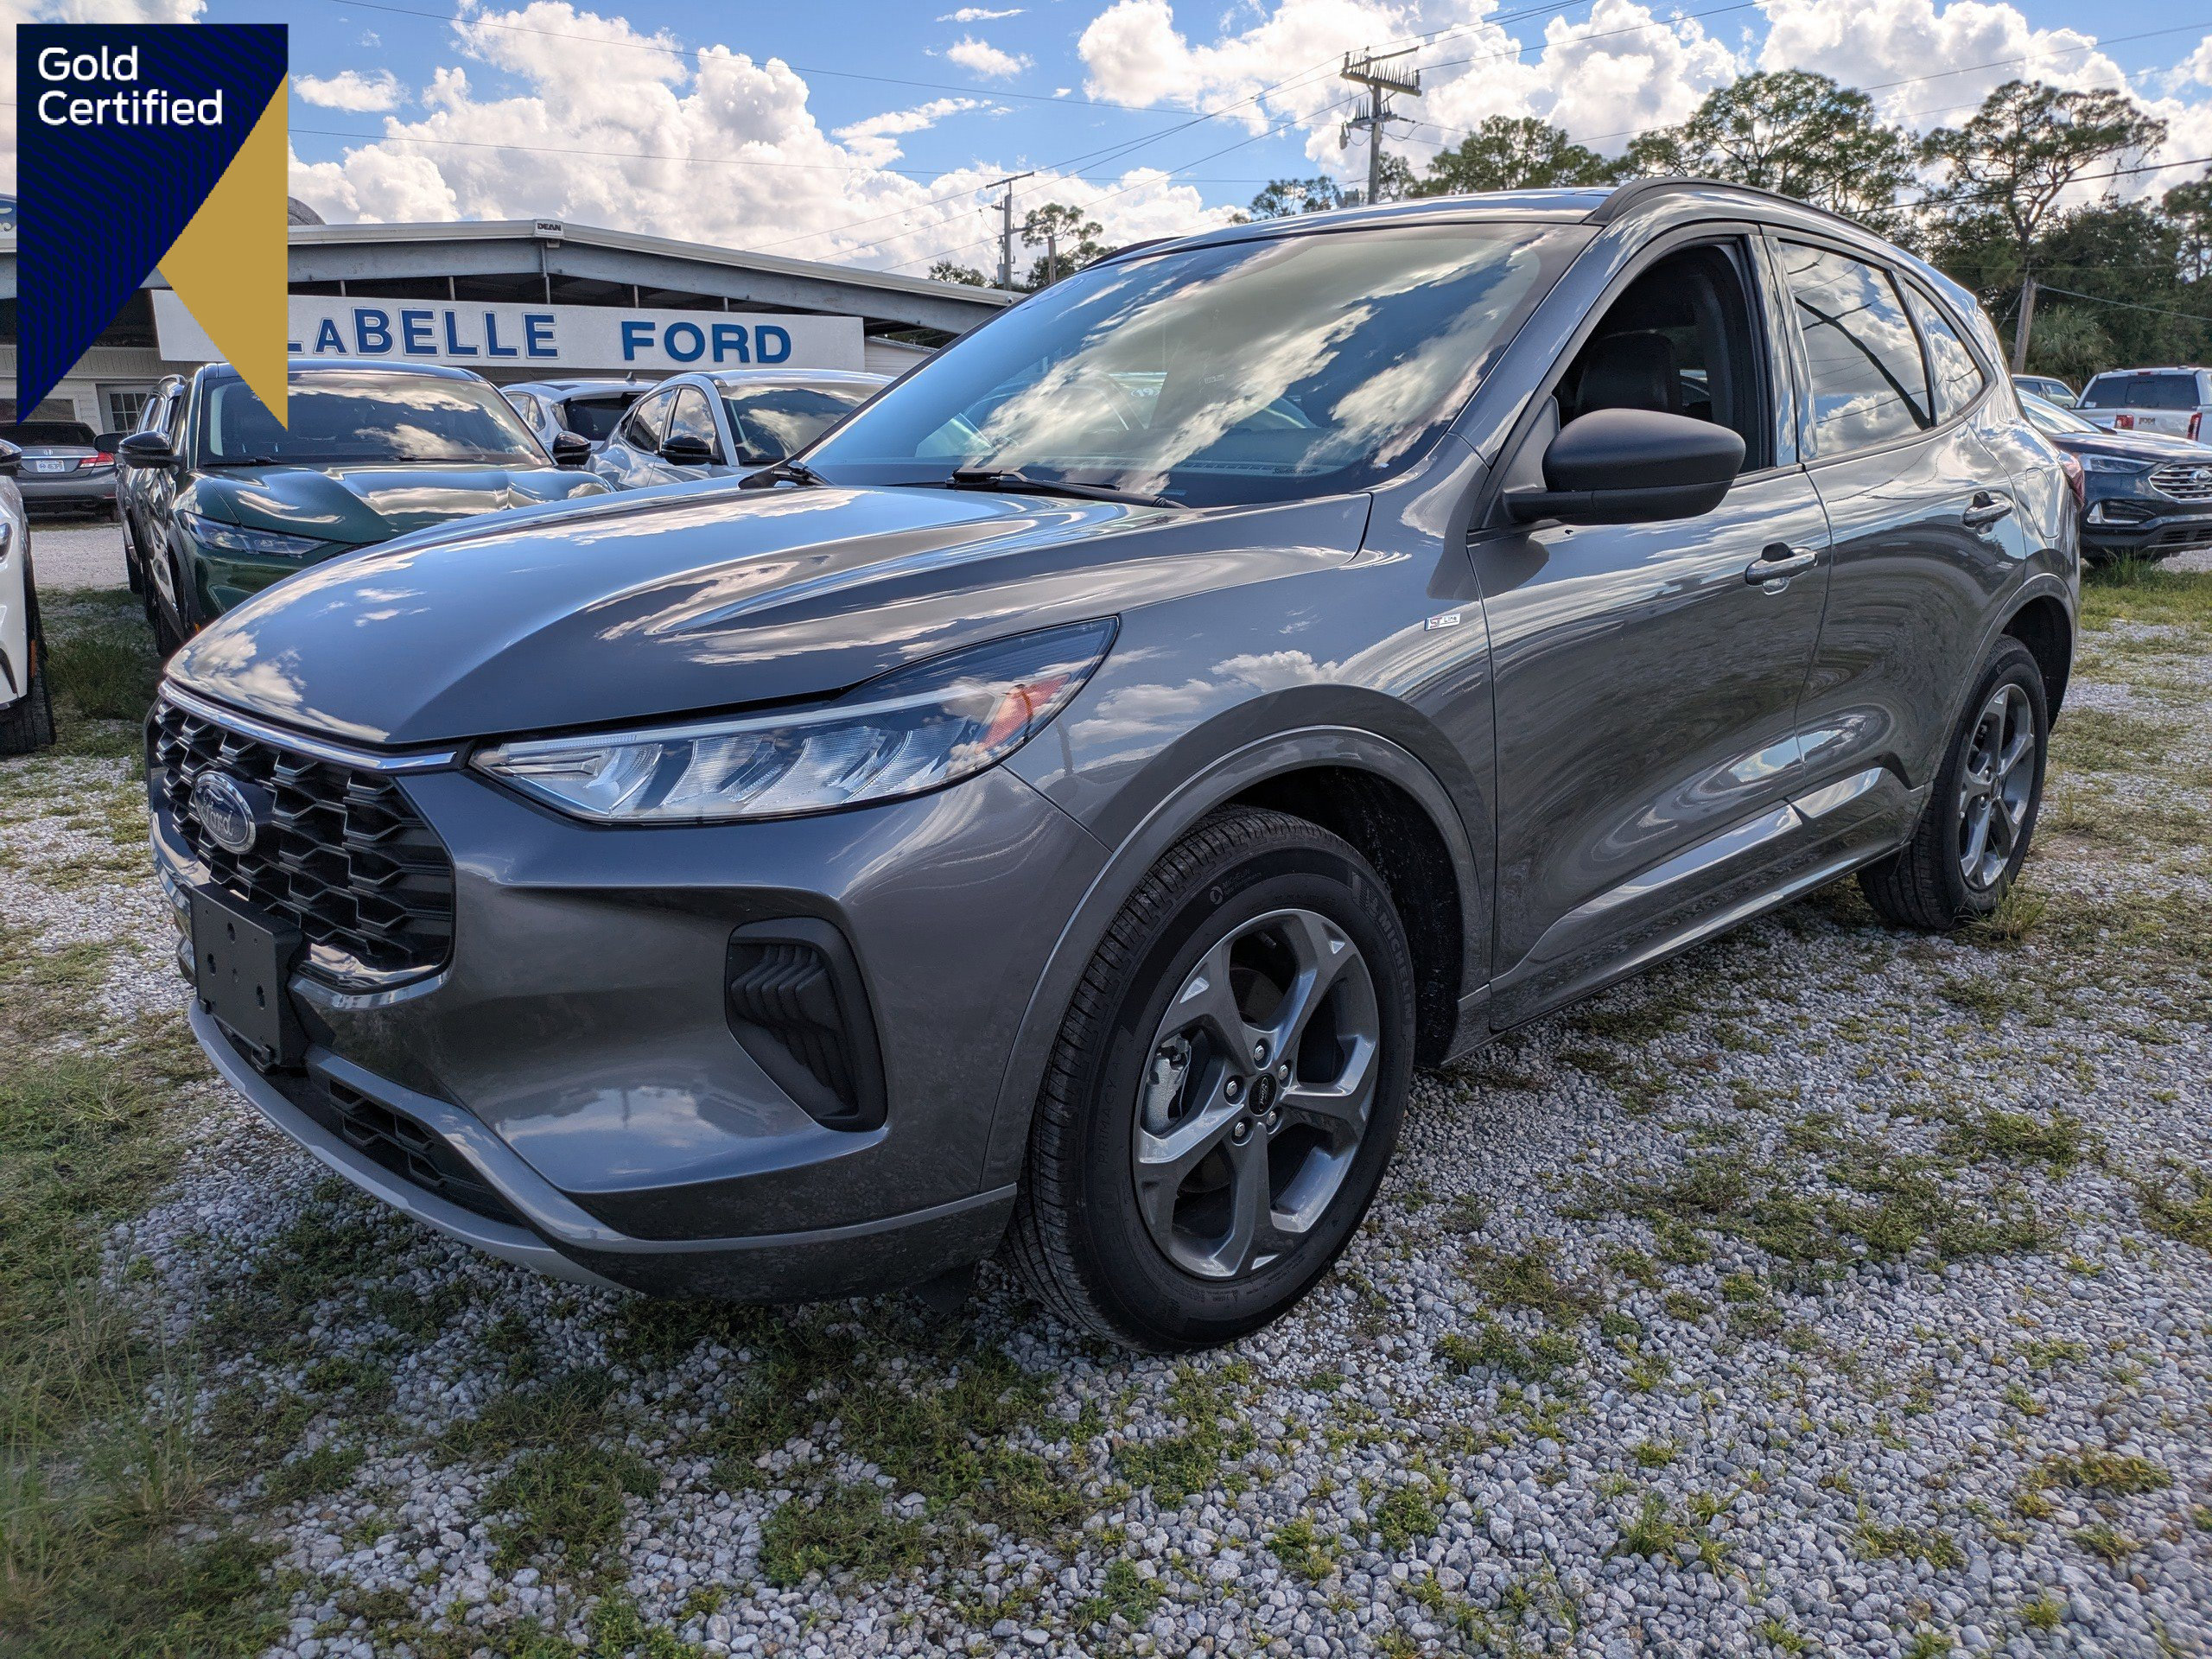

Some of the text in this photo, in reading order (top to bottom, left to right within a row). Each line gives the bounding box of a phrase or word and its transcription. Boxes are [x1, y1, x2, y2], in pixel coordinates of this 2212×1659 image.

[537, 222, 562, 232] DEAN
[288, 306, 792, 364] ABELLE FORD
[200, 787, 234, 836] Ford
[1377, 911, 1414, 1020] MICHELIN
